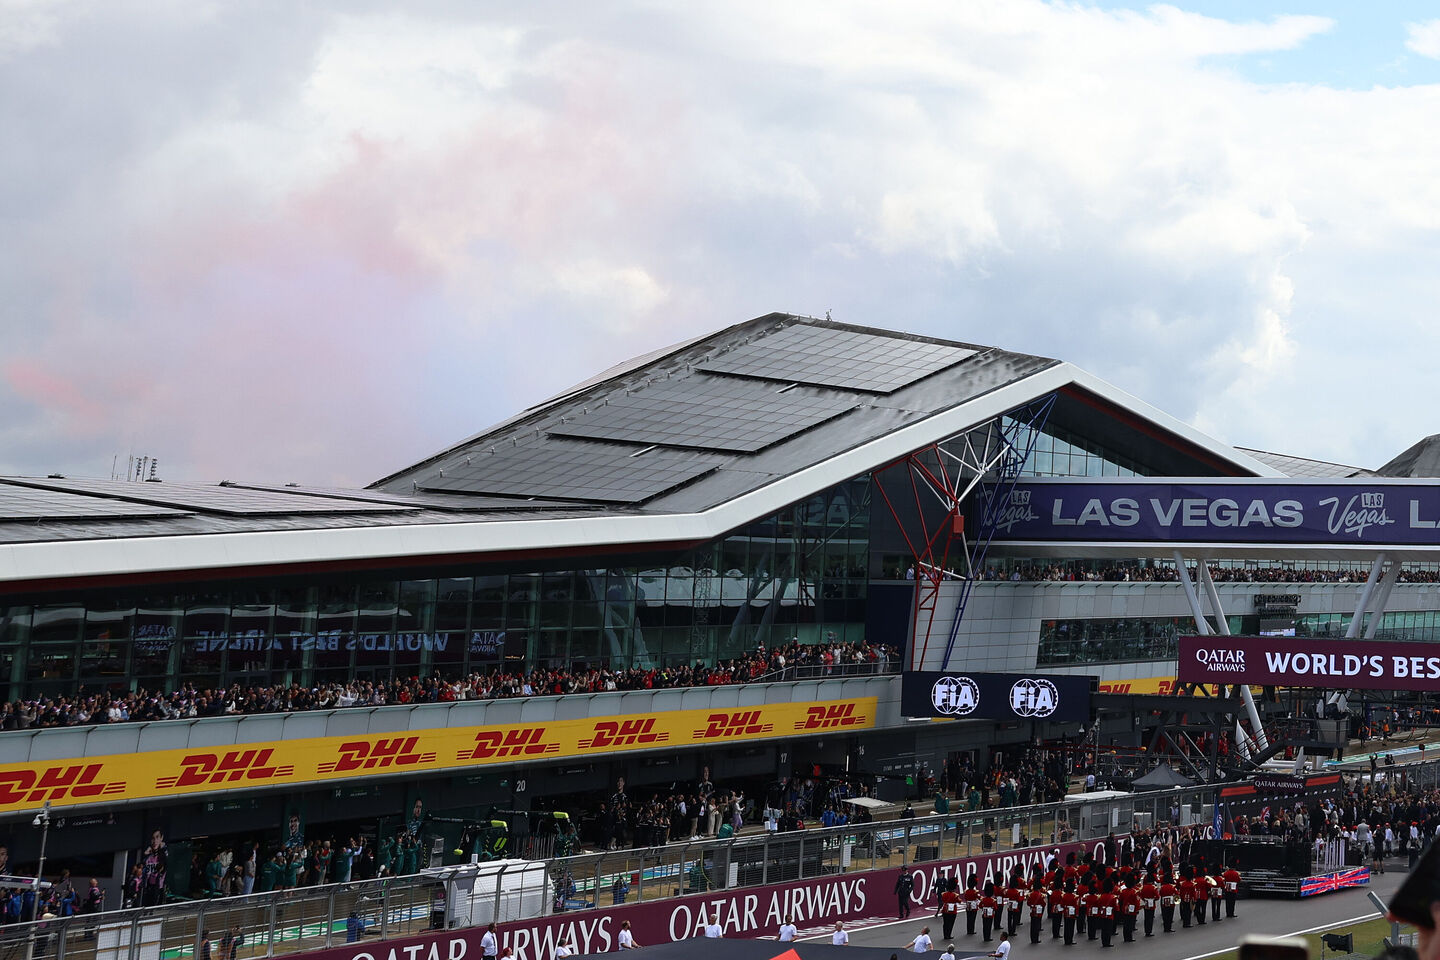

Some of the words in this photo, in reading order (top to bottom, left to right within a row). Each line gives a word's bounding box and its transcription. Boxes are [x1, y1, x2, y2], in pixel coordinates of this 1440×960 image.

[1052, 498, 1141, 527] LAS
[1150, 498, 1304, 528] VEGAS
[1363, 493, 1383, 507] LAS
[1319, 494, 1395, 538] Vegas
[1195, 648, 1246, 665] QATAR
[1207, 663, 1246, 673] AIRWAYS
[1265, 652, 1384, 677] WORLD'S
[704, 710, 762, 738] DHL
[805, 703, 856, 729] DHL
[470, 728, 546, 759] DHL
[590, 718, 656, 748] DHL
[175, 748, 275, 787] DHL
[334, 736, 420, 772] DHL
[0, 763, 104, 805] DHL
[516, 780, 526, 792] 20
[1255, 779, 1276, 788] QATAR
[1276, 780, 1304, 789] AIRWAYS
[669, 894, 759, 942] QATAR
[764, 878, 867, 928] AIRWAYS
[502, 916, 613, 960] IRWAYS
